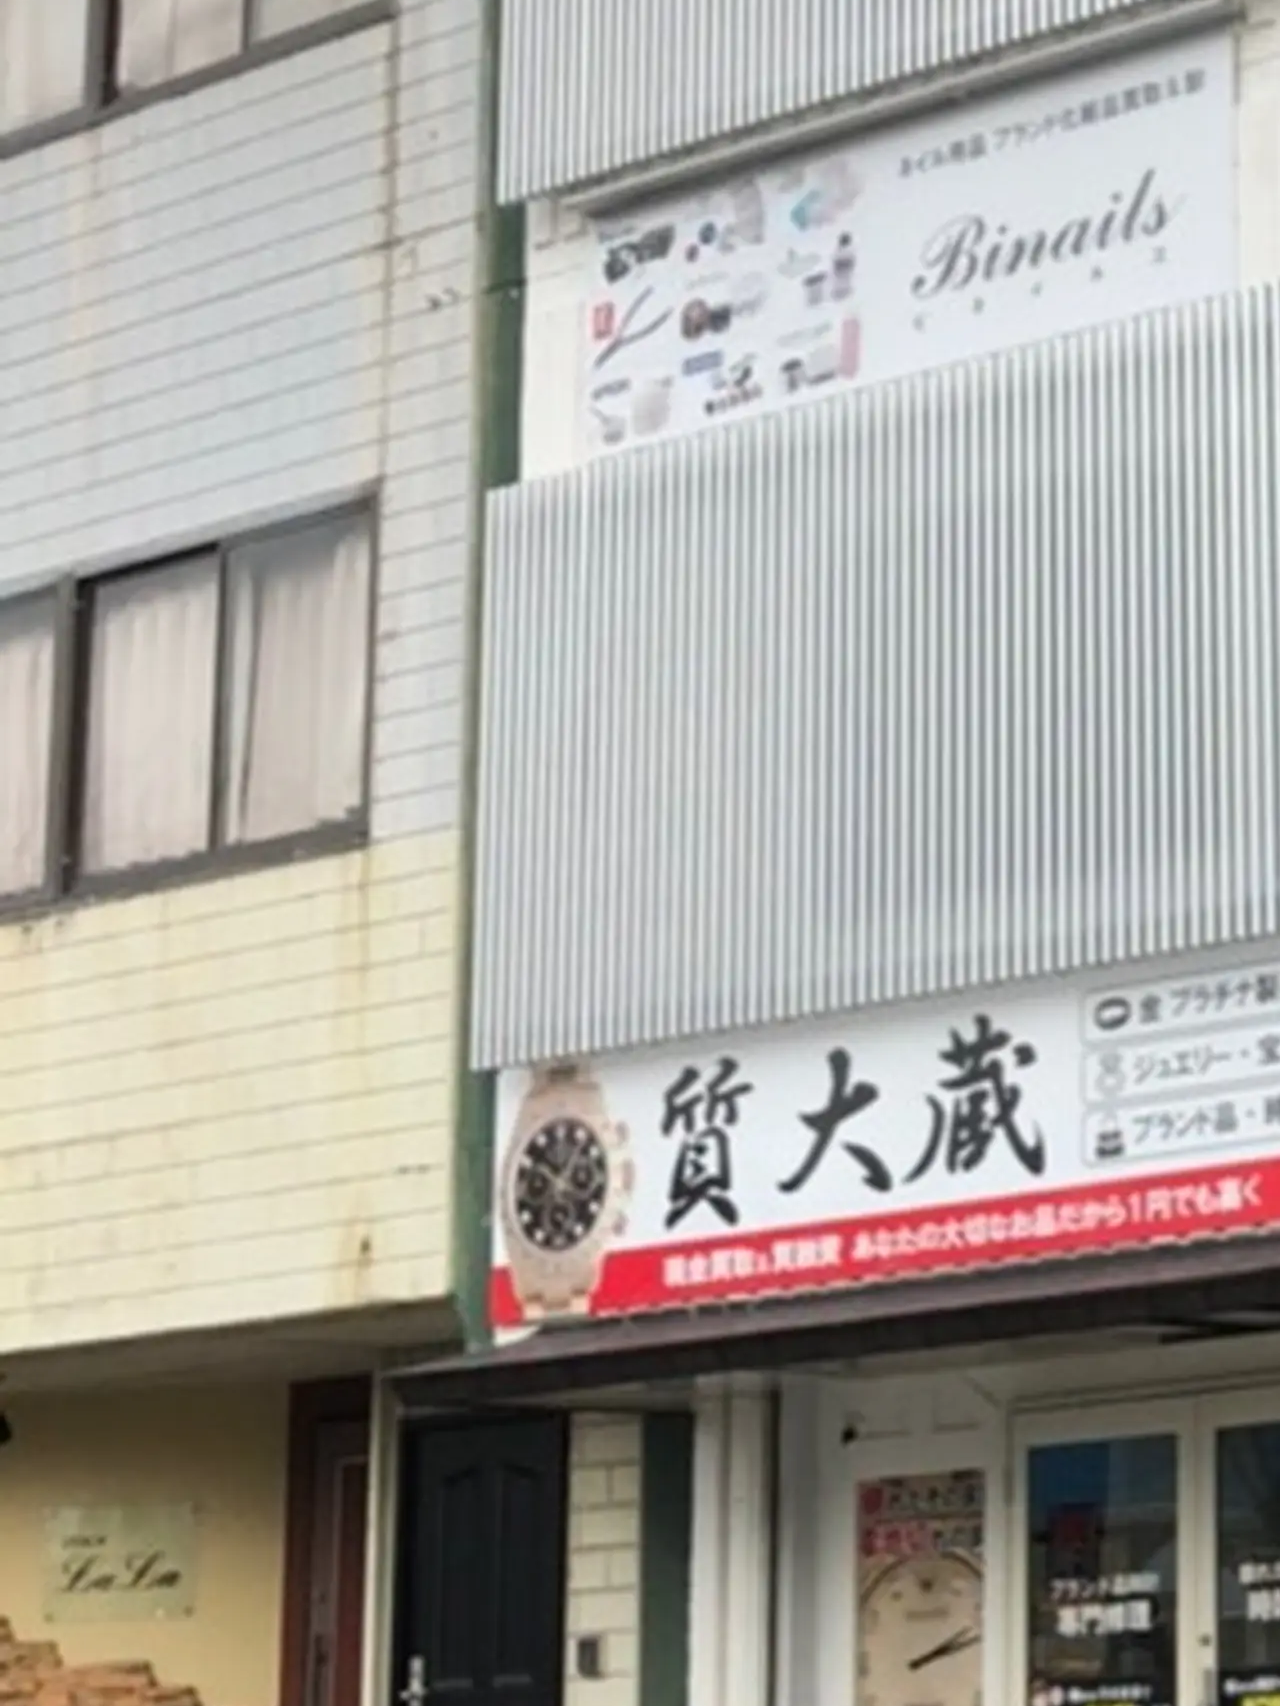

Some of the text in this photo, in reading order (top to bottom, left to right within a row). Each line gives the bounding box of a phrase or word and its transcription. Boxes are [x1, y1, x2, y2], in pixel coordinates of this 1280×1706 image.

[910, 167, 1188, 299] Binails
[663, 1014, 1046, 1231] 質大蔵
